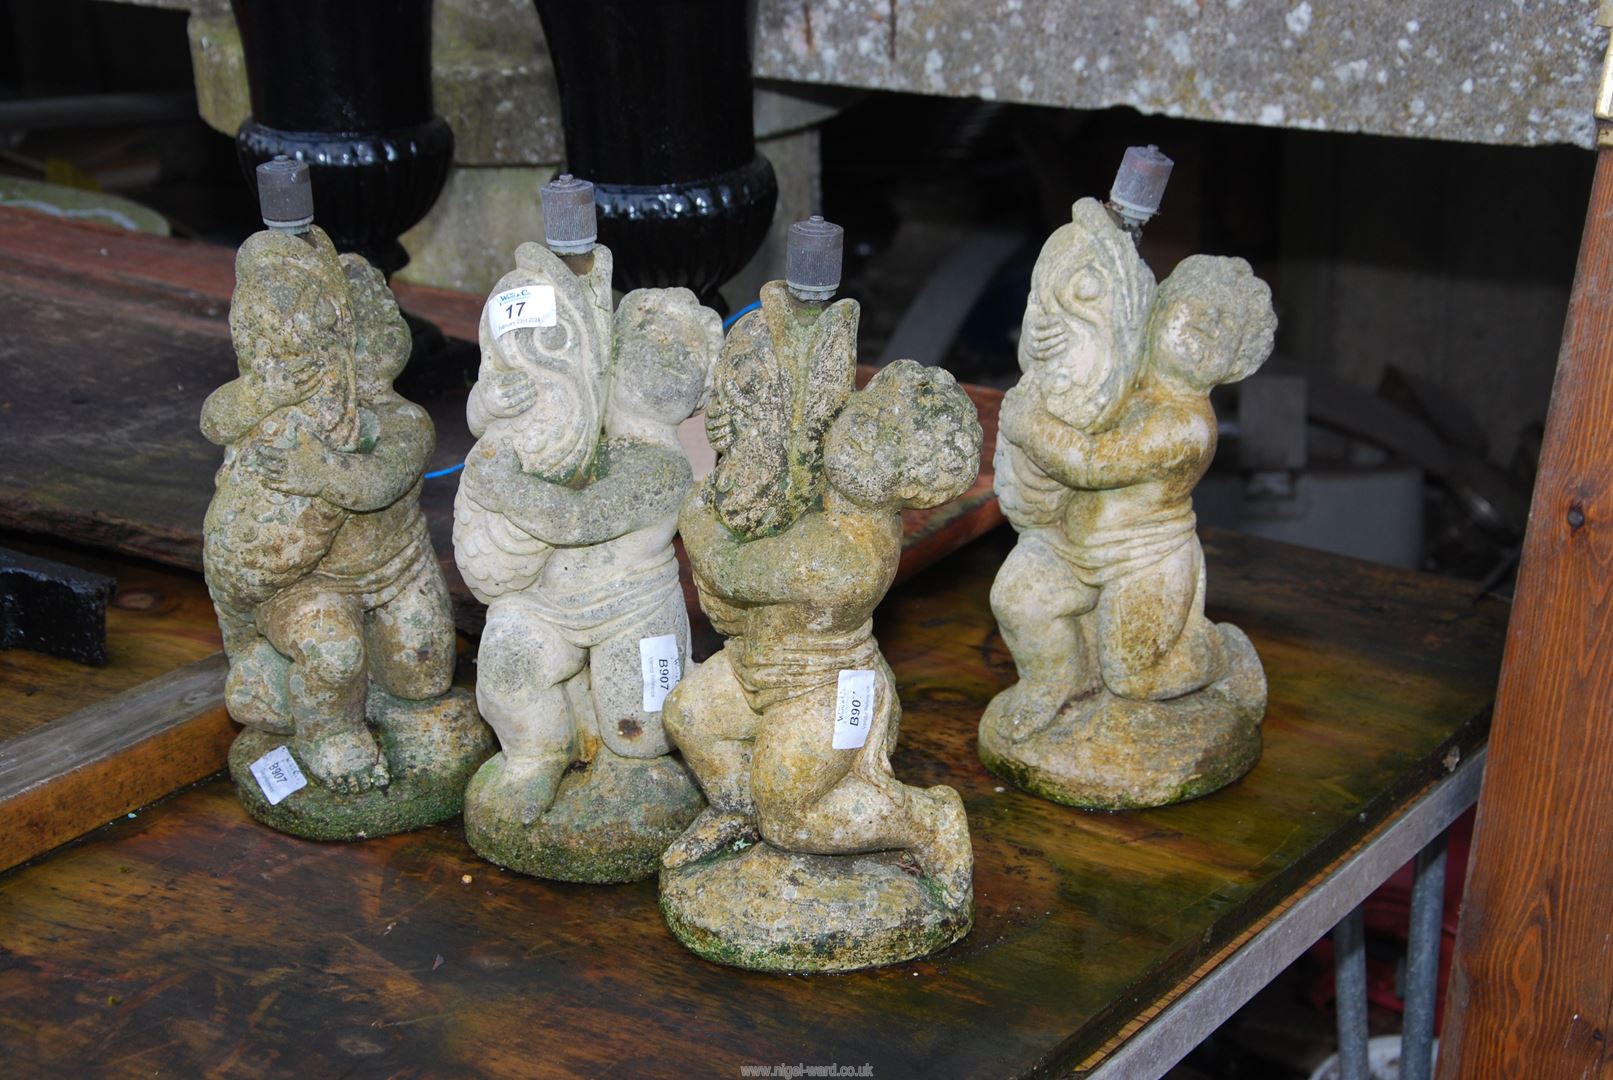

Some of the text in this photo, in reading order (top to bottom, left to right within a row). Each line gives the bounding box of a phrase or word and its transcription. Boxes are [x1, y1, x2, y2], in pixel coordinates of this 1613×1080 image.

[505, 301, 526, 319] 17
[659, 659, 670, 690] B907
[849, 691, 862, 726] B90
